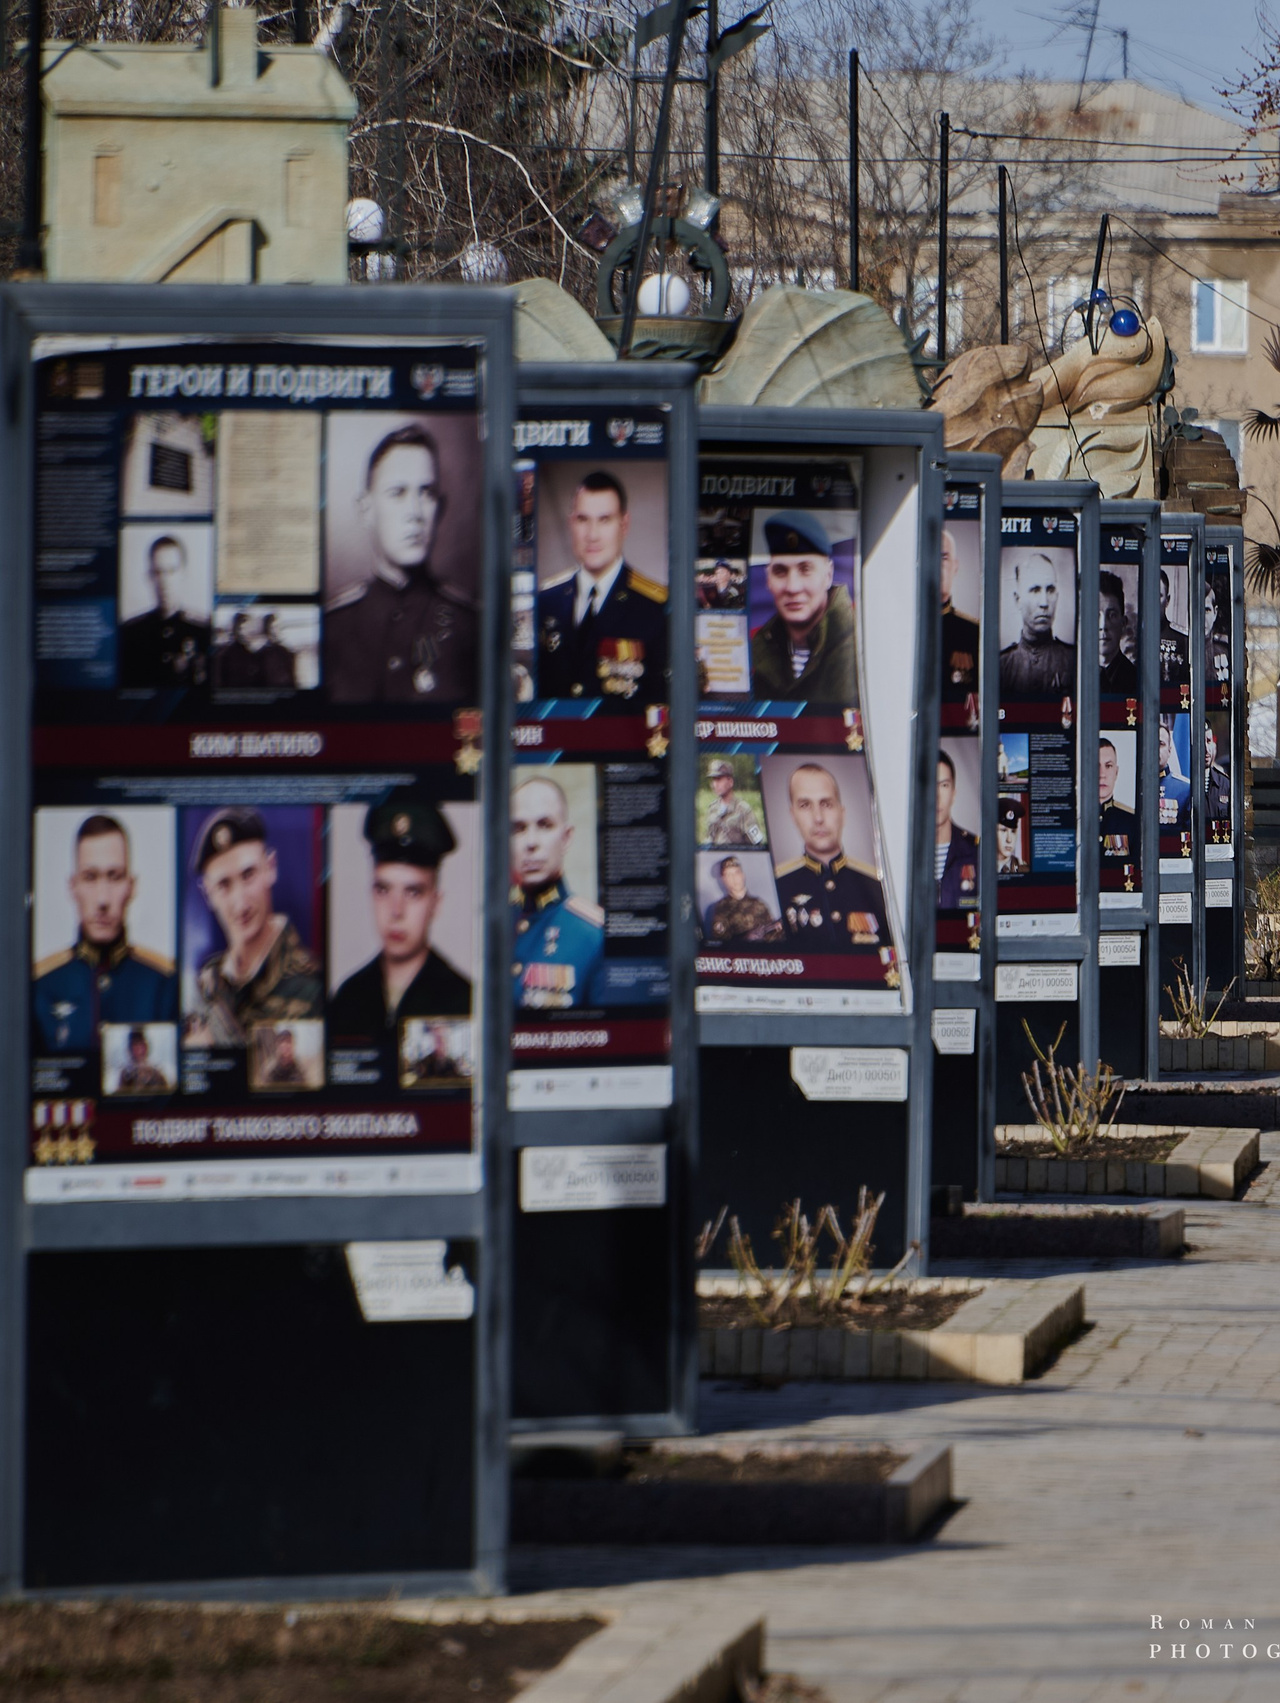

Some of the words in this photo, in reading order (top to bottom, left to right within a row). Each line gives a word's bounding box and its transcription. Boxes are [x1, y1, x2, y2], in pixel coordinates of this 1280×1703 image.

[129, 364, 224, 398] ГЕРОИ
[226, 364, 251, 398] И
[253, 365, 393, 404] ПОДВИГИ
[701, 474, 797, 499] ПОДВИГИ
[715, 721, 779, 740] ШИШКОВ
[733, 957, 805, 977] ЯГИДАРОВ
